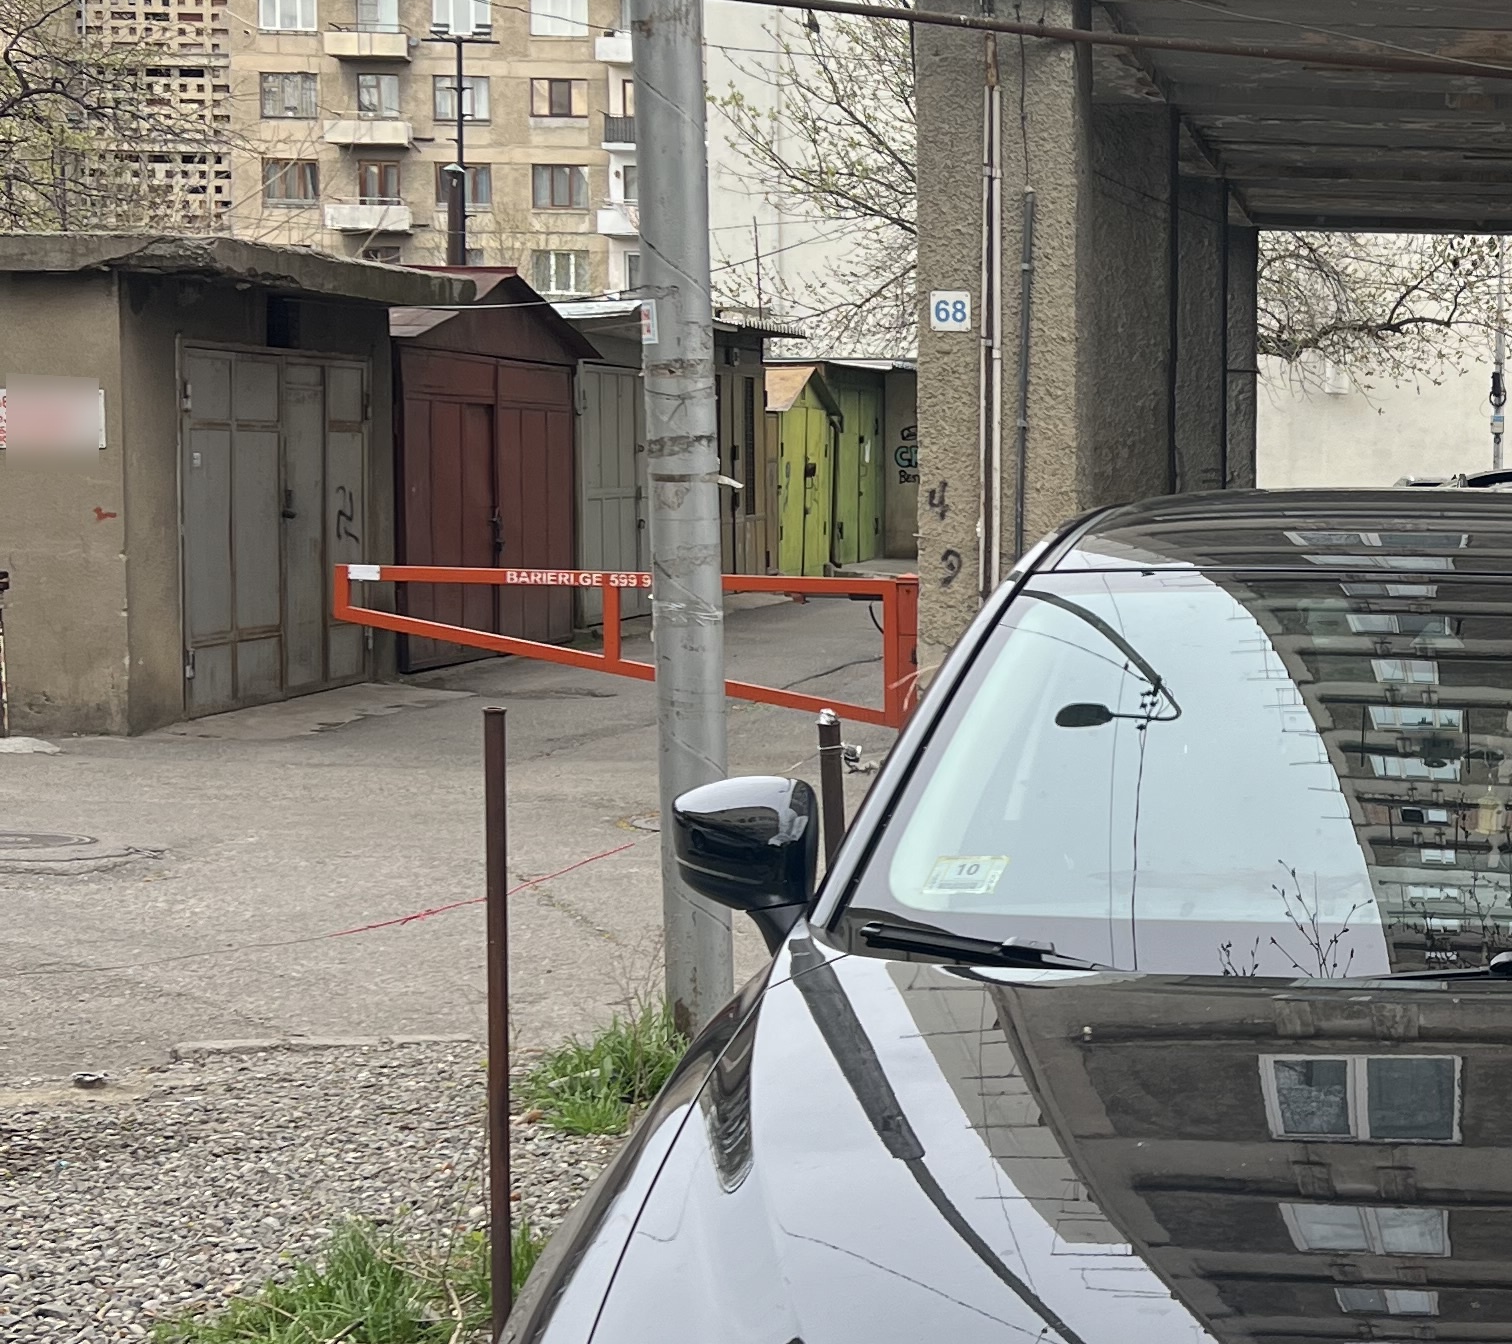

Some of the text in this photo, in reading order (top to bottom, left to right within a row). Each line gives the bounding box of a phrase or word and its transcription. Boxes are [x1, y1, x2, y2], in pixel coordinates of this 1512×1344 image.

[935, 299, 967, 323] 68
[505, 570, 604, 587] BARIERI.GE
[609, 573, 638, 588] 599
[956, 863, 981, 876] 10
